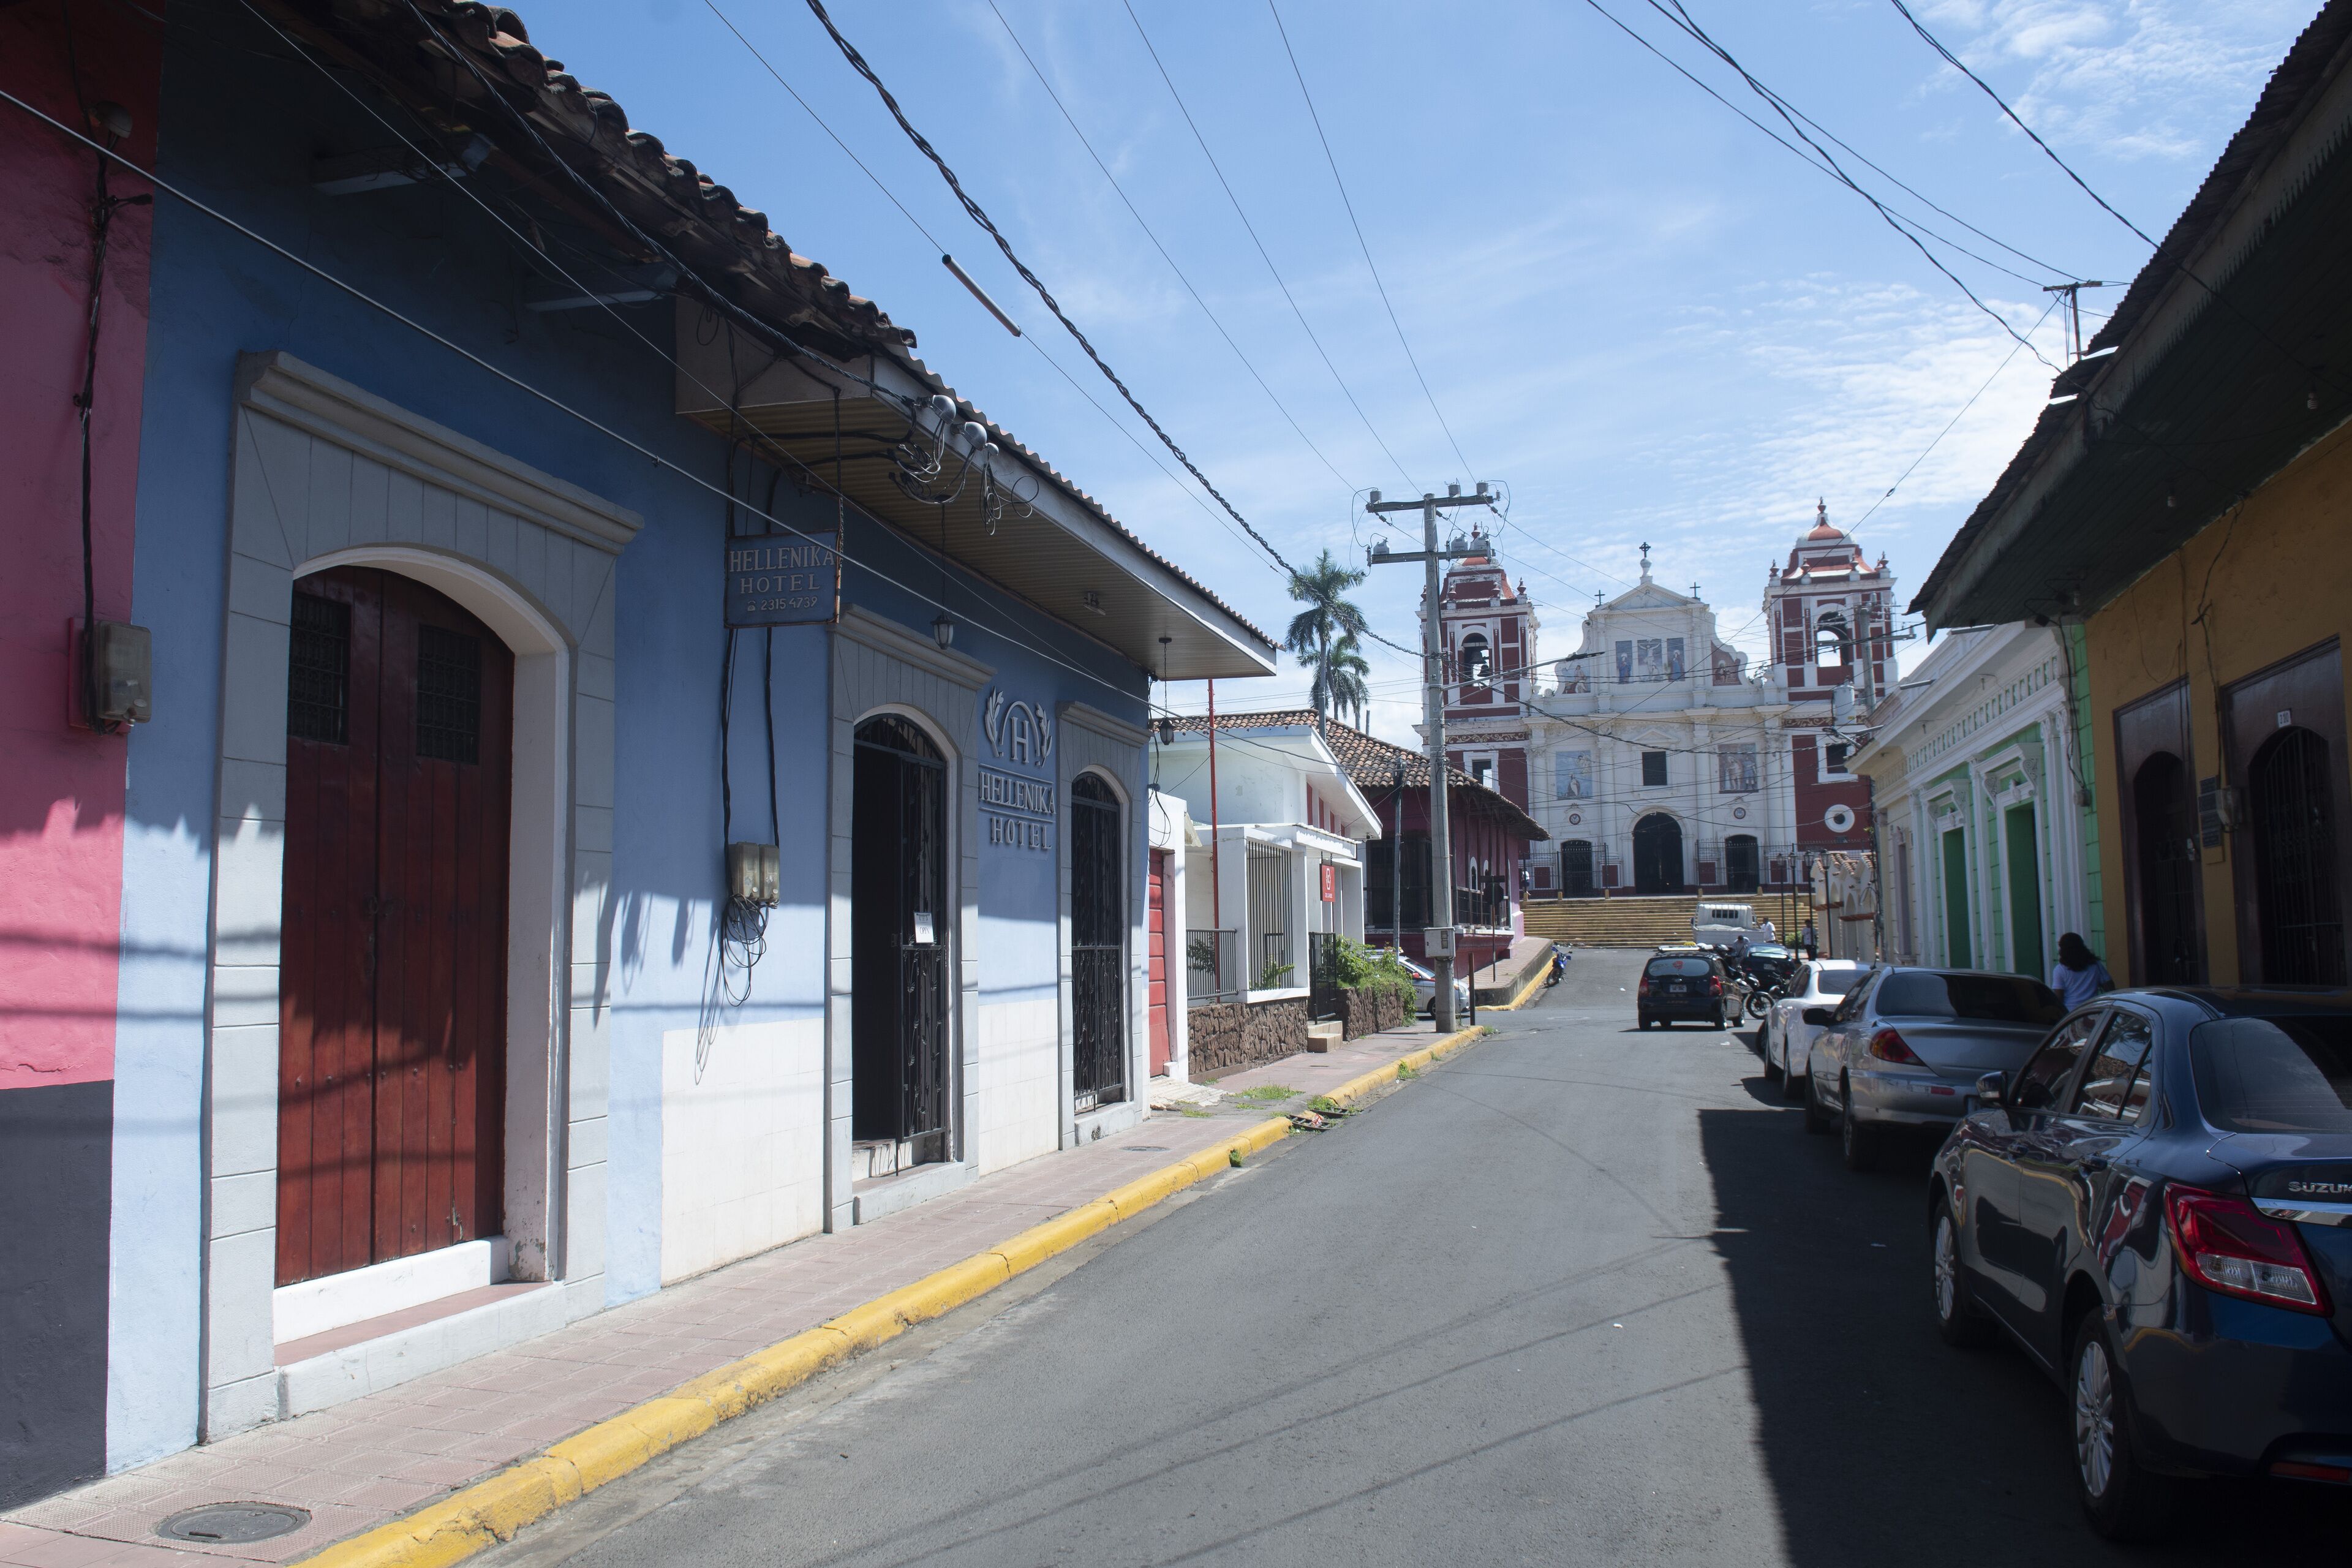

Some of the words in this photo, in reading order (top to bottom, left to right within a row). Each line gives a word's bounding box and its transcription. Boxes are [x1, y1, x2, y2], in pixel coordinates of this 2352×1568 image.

[729, 545, 835, 572] HELLENIKA
[740, 573, 821, 594] HOTEL
[1011, 716, 1030, 764] H
[979, 771, 1057, 815] HELLENIKA
[991, 816, 1052, 850] HOTEL
